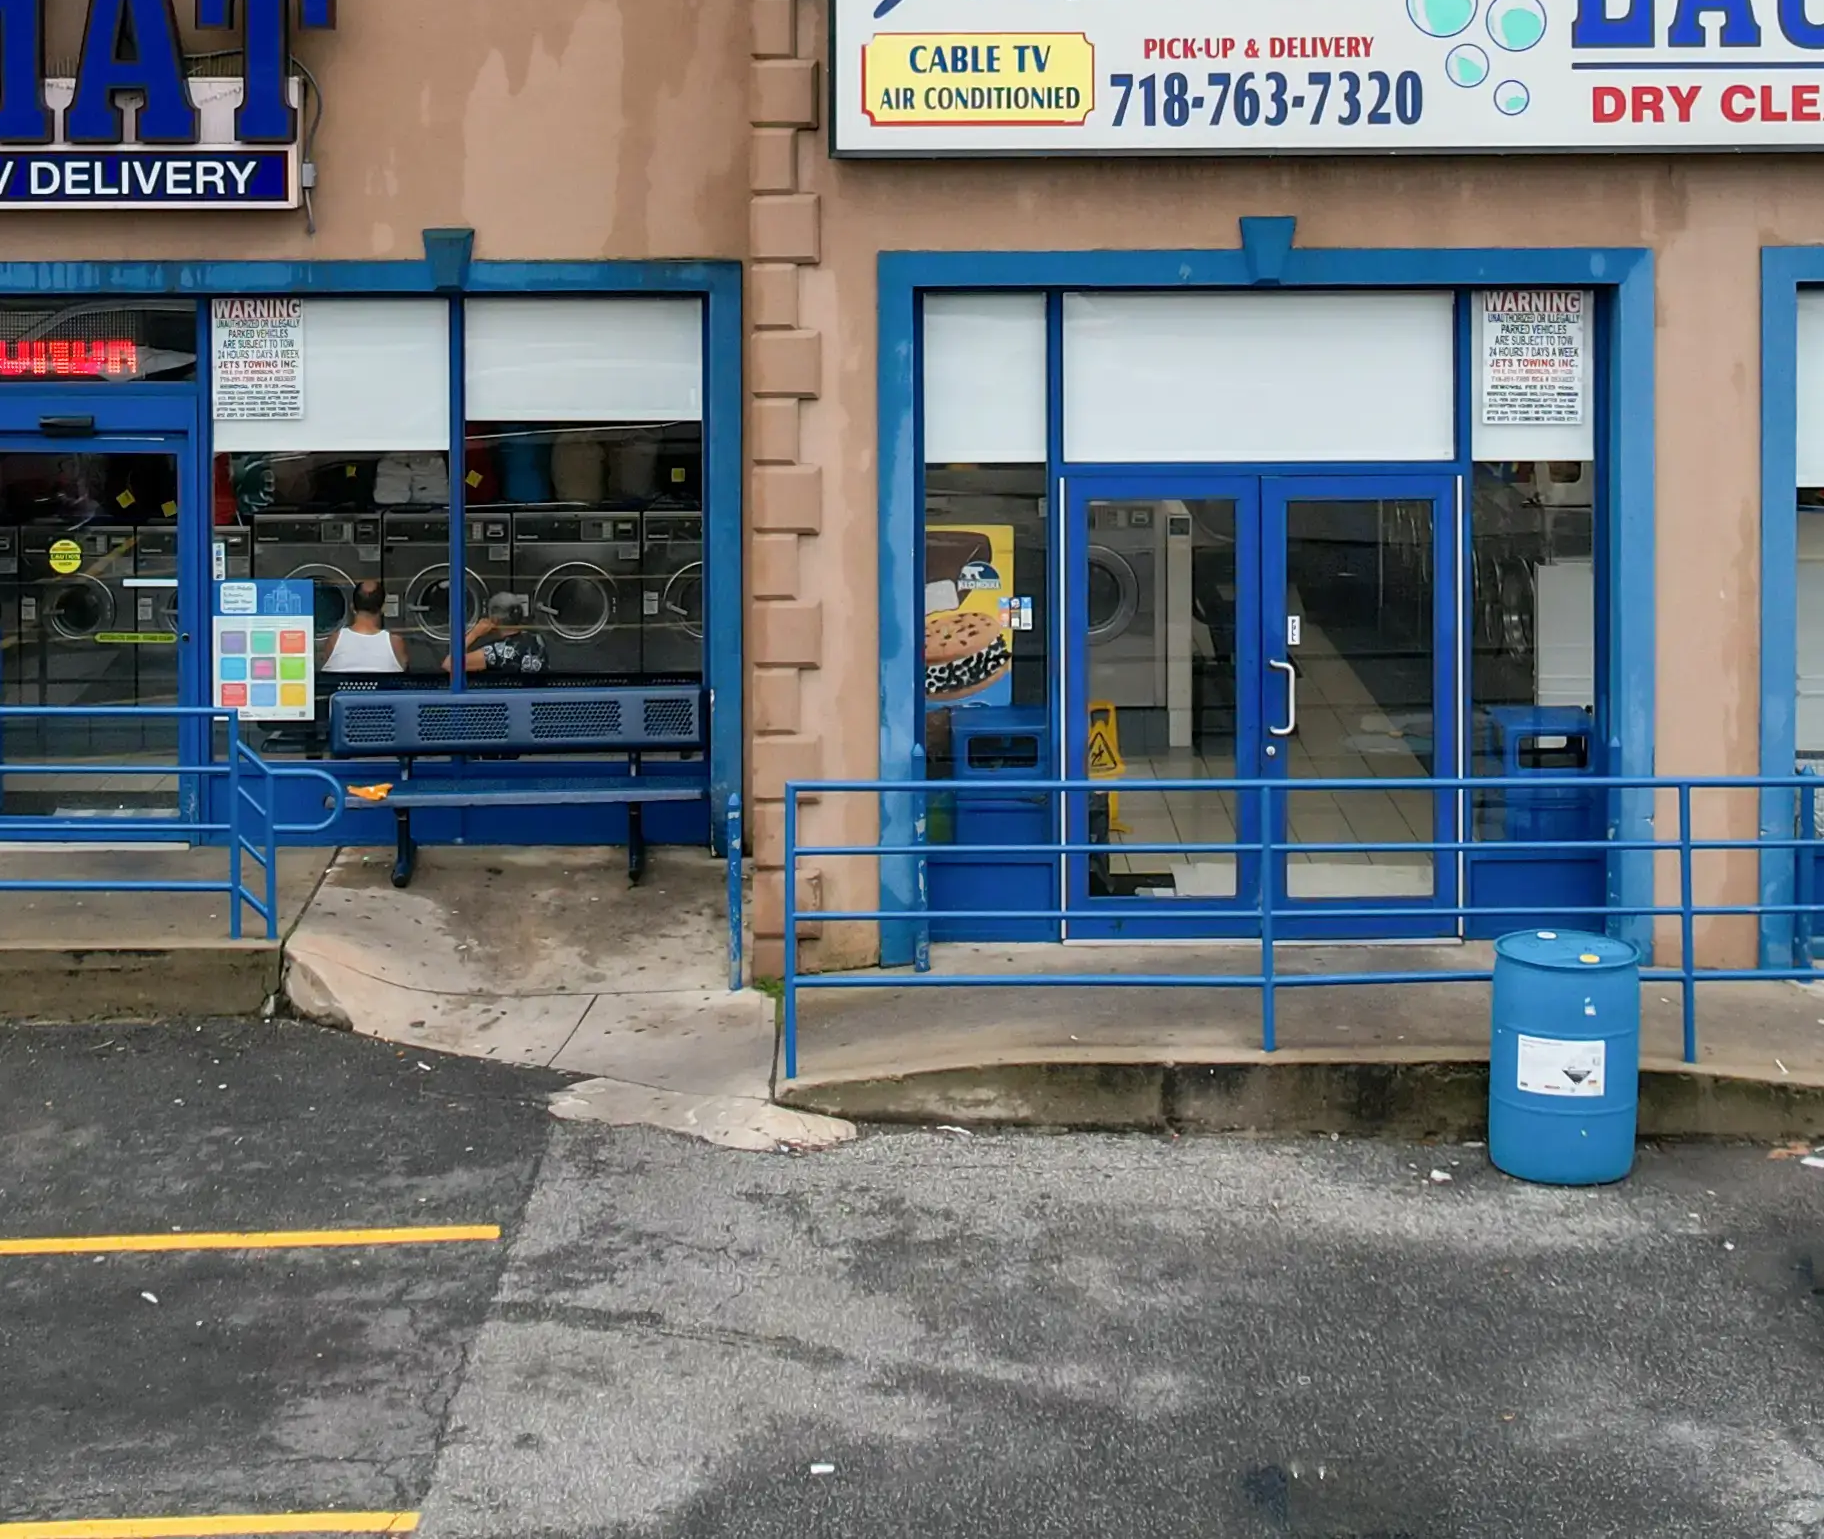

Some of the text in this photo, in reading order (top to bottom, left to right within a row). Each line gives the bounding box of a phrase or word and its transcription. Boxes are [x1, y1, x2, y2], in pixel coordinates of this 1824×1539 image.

[1142, 36, 1376, 60] PICK-UP & DELIVERY
[909, 44, 1053, 74] CABLE TV
[880, 86, 1081, 110] AIR CONDITIONIED
[1110, 69, 1424, 128] 718-763-7320
[1591, 85, 1703, 124] DRY
[29, 161, 258, 196] DELIVERY
[216, 300, 301, 318] WARNING
[1485, 292, 1580, 312] WARNING
[1548, 313, 1580, 323] ILLEGALLY
[1501, 325, 1567, 334] PARKED VEHICLES
[1495, 336, 1574, 345] ARE SUBJECT TO TOW
[1499, 347, 1524, 357] HOURS
[1531, 347, 1550, 357] DAYS
[1558, 347, 1579, 357] WEEK
[1489, 359, 1513, 367] JETS
[1517, 359, 1555, 367] TOWING
